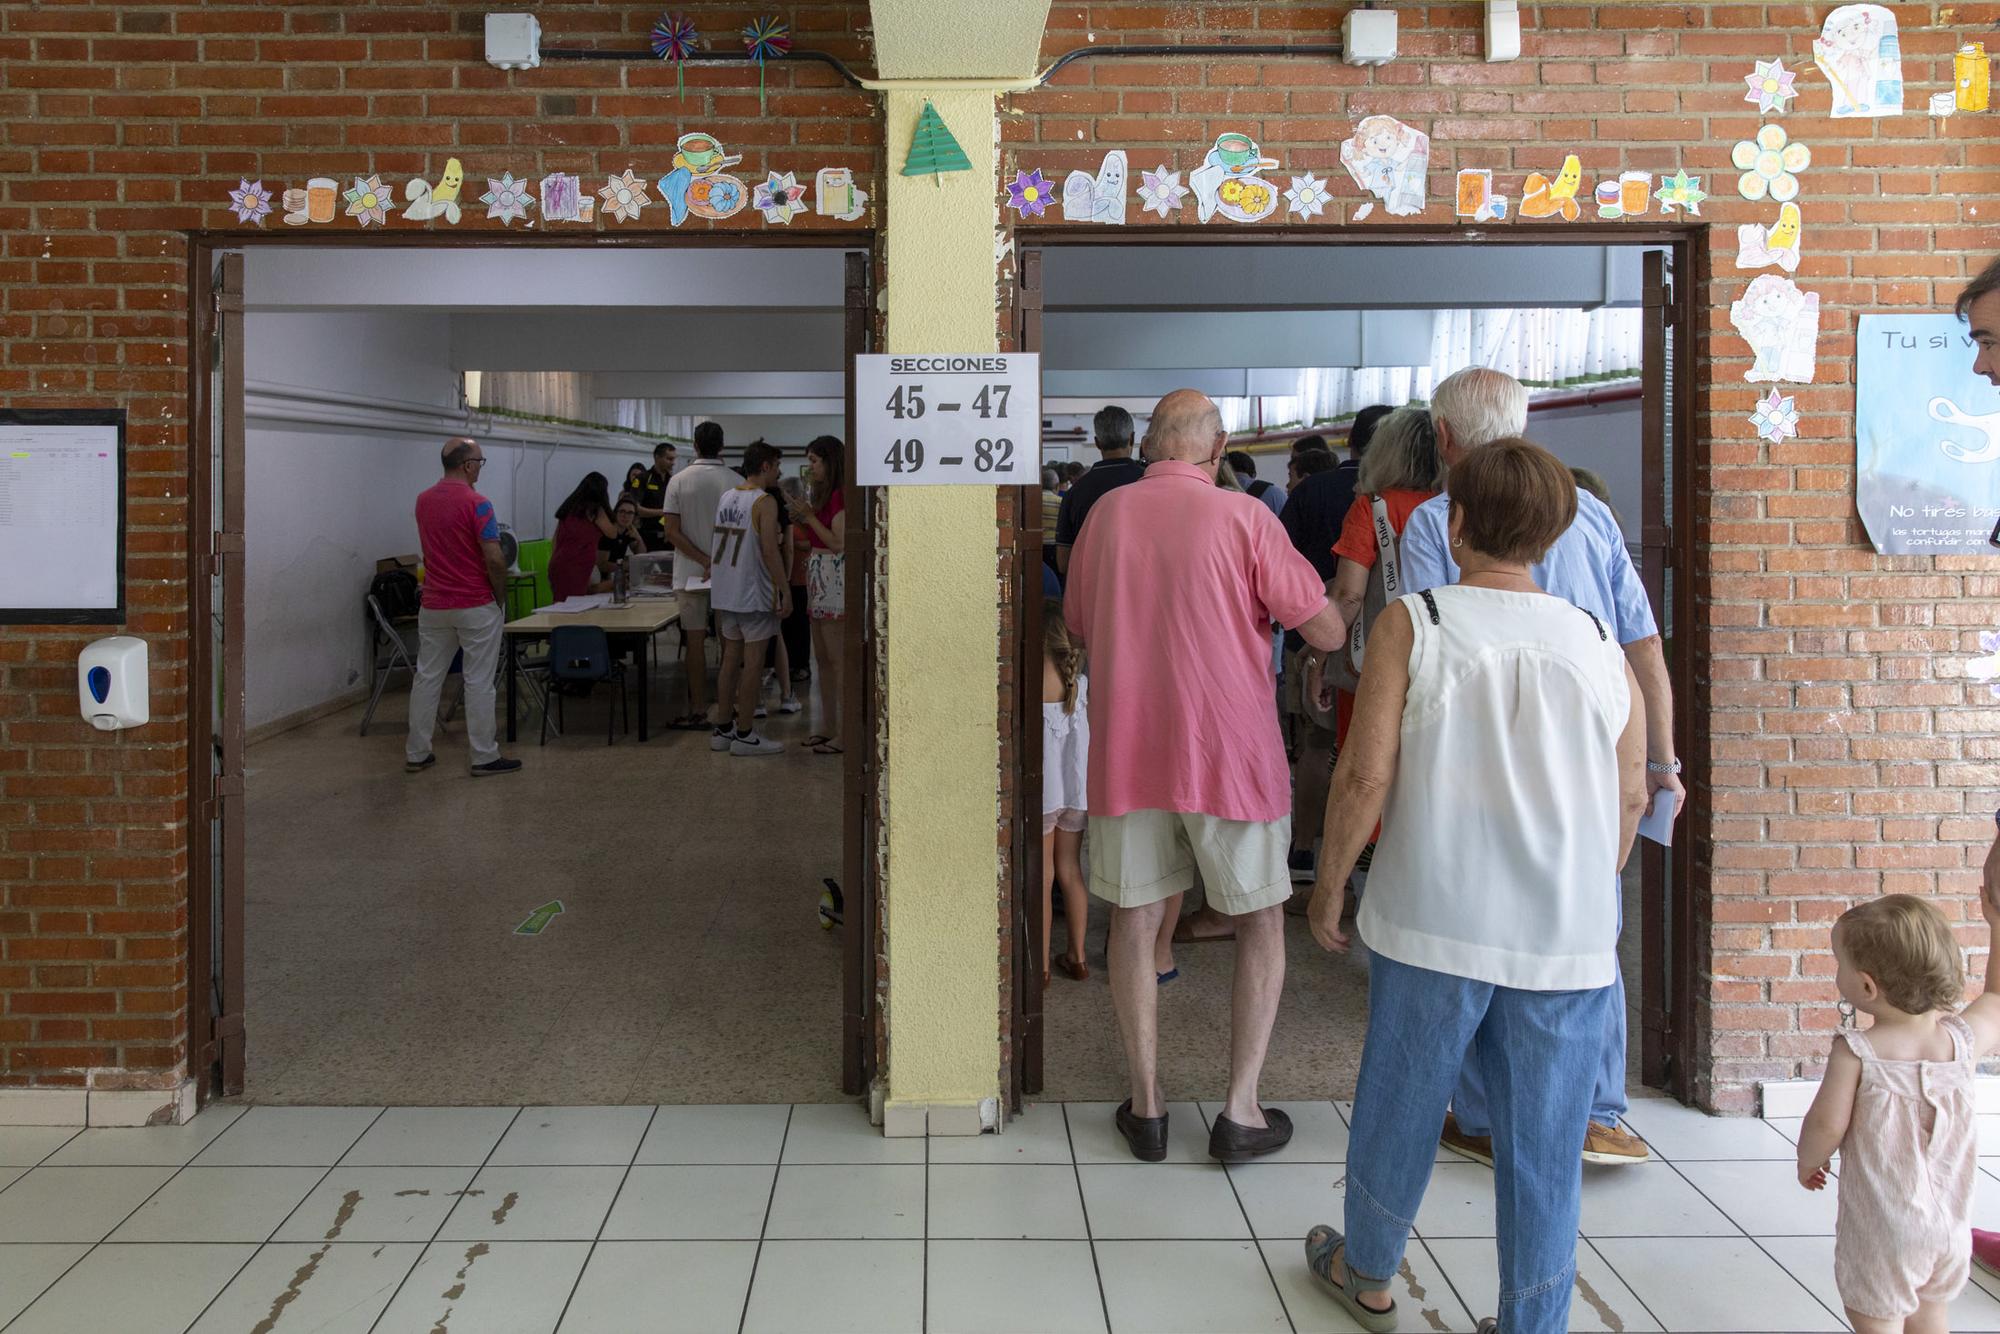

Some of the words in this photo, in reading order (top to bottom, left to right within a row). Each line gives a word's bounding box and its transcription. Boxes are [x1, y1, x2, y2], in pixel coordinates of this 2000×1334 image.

[1881, 331, 1917, 349] Tu
[1929, 332, 1948, 349] si
[1961, 335, 1974, 348] v
[890, 358, 1008, 372] SECCIONES
[886, 384, 926, 419] 45
[972, 384, 1012, 419] 47
[884, 438, 925, 473] 49
[974, 438, 1014, 473] 82
[1889, 504, 1915, 518] No
[1922, 504, 1967, 518] tires
[1973, 505, 2000, 518] bas
[1376, 515, 1390, 548] Chloé
[1892, 528, 1908, 536] las
[1912, 528, 1962, 539] tortugas
[1906, 537, 1962, 546] confundir
[712, 526, 748, 568] 77
[1386, 560, 1397, 592] Chloé
